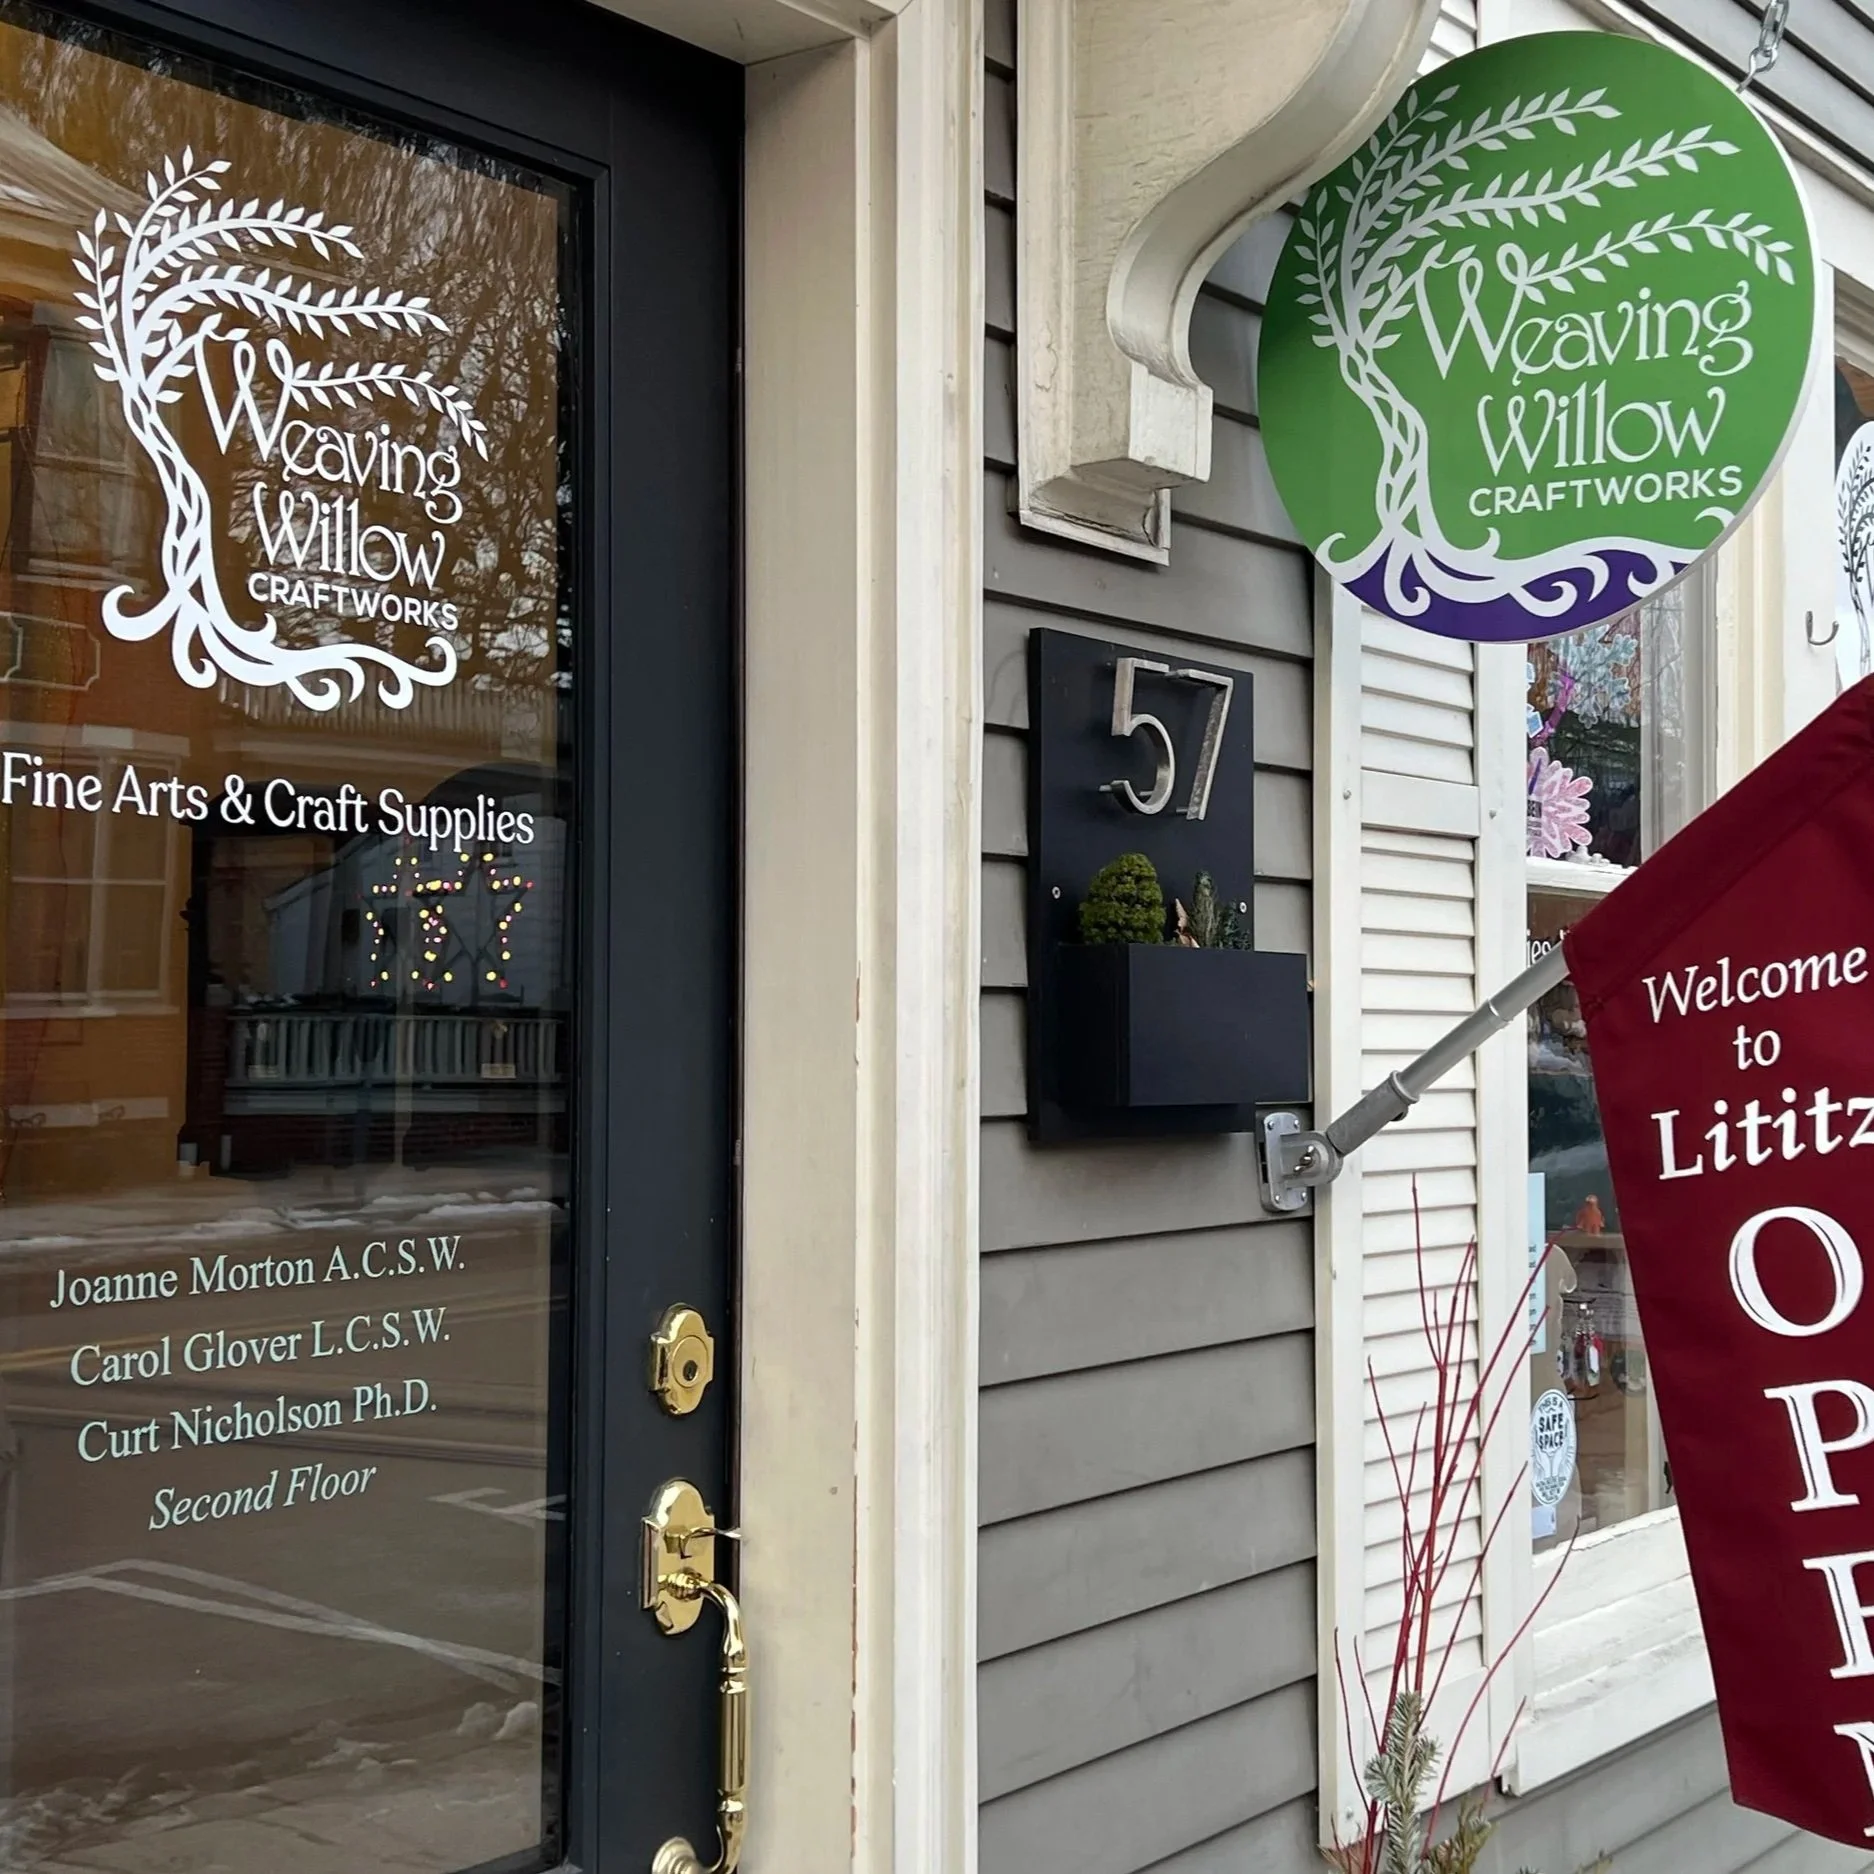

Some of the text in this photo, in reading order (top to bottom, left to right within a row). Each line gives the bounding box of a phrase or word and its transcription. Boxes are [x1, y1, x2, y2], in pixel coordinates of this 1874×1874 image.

[1414, 243, 1754, 386] Weaving
[195, 337, 463, 524] Weaving
[1477, 379, 1727, 477] Willow
[1468, 465, 1743, 518] CRAFTWORKS
[252, 481, 446, 590] Willow
[248, 571, 459, 632] CRAFTWORKS
[1110, 656, 1234, 821] 57
[1, 751, 535, 852] Fine Arts & Craft Supplies
[1642, 946, 1869, 1024] Welcome
[1733, 1024, 1782, 1071] to
[1651, 1086, 1874, 1180] Lititz
[50, 1235, 466, 1308] Joanne Morton A.C.S.W.
[70, 1306, 452, 1387] Carol Glover L.C.S.W.
[78, 1378, 437, 1463] Curt Nicholson Ph.D.
[1538, 1413, 1564, 1433] SAFE
[1538, 1430, 1564, 1450] SPACE
[148, 1462, 377, 1531] Second Floor
